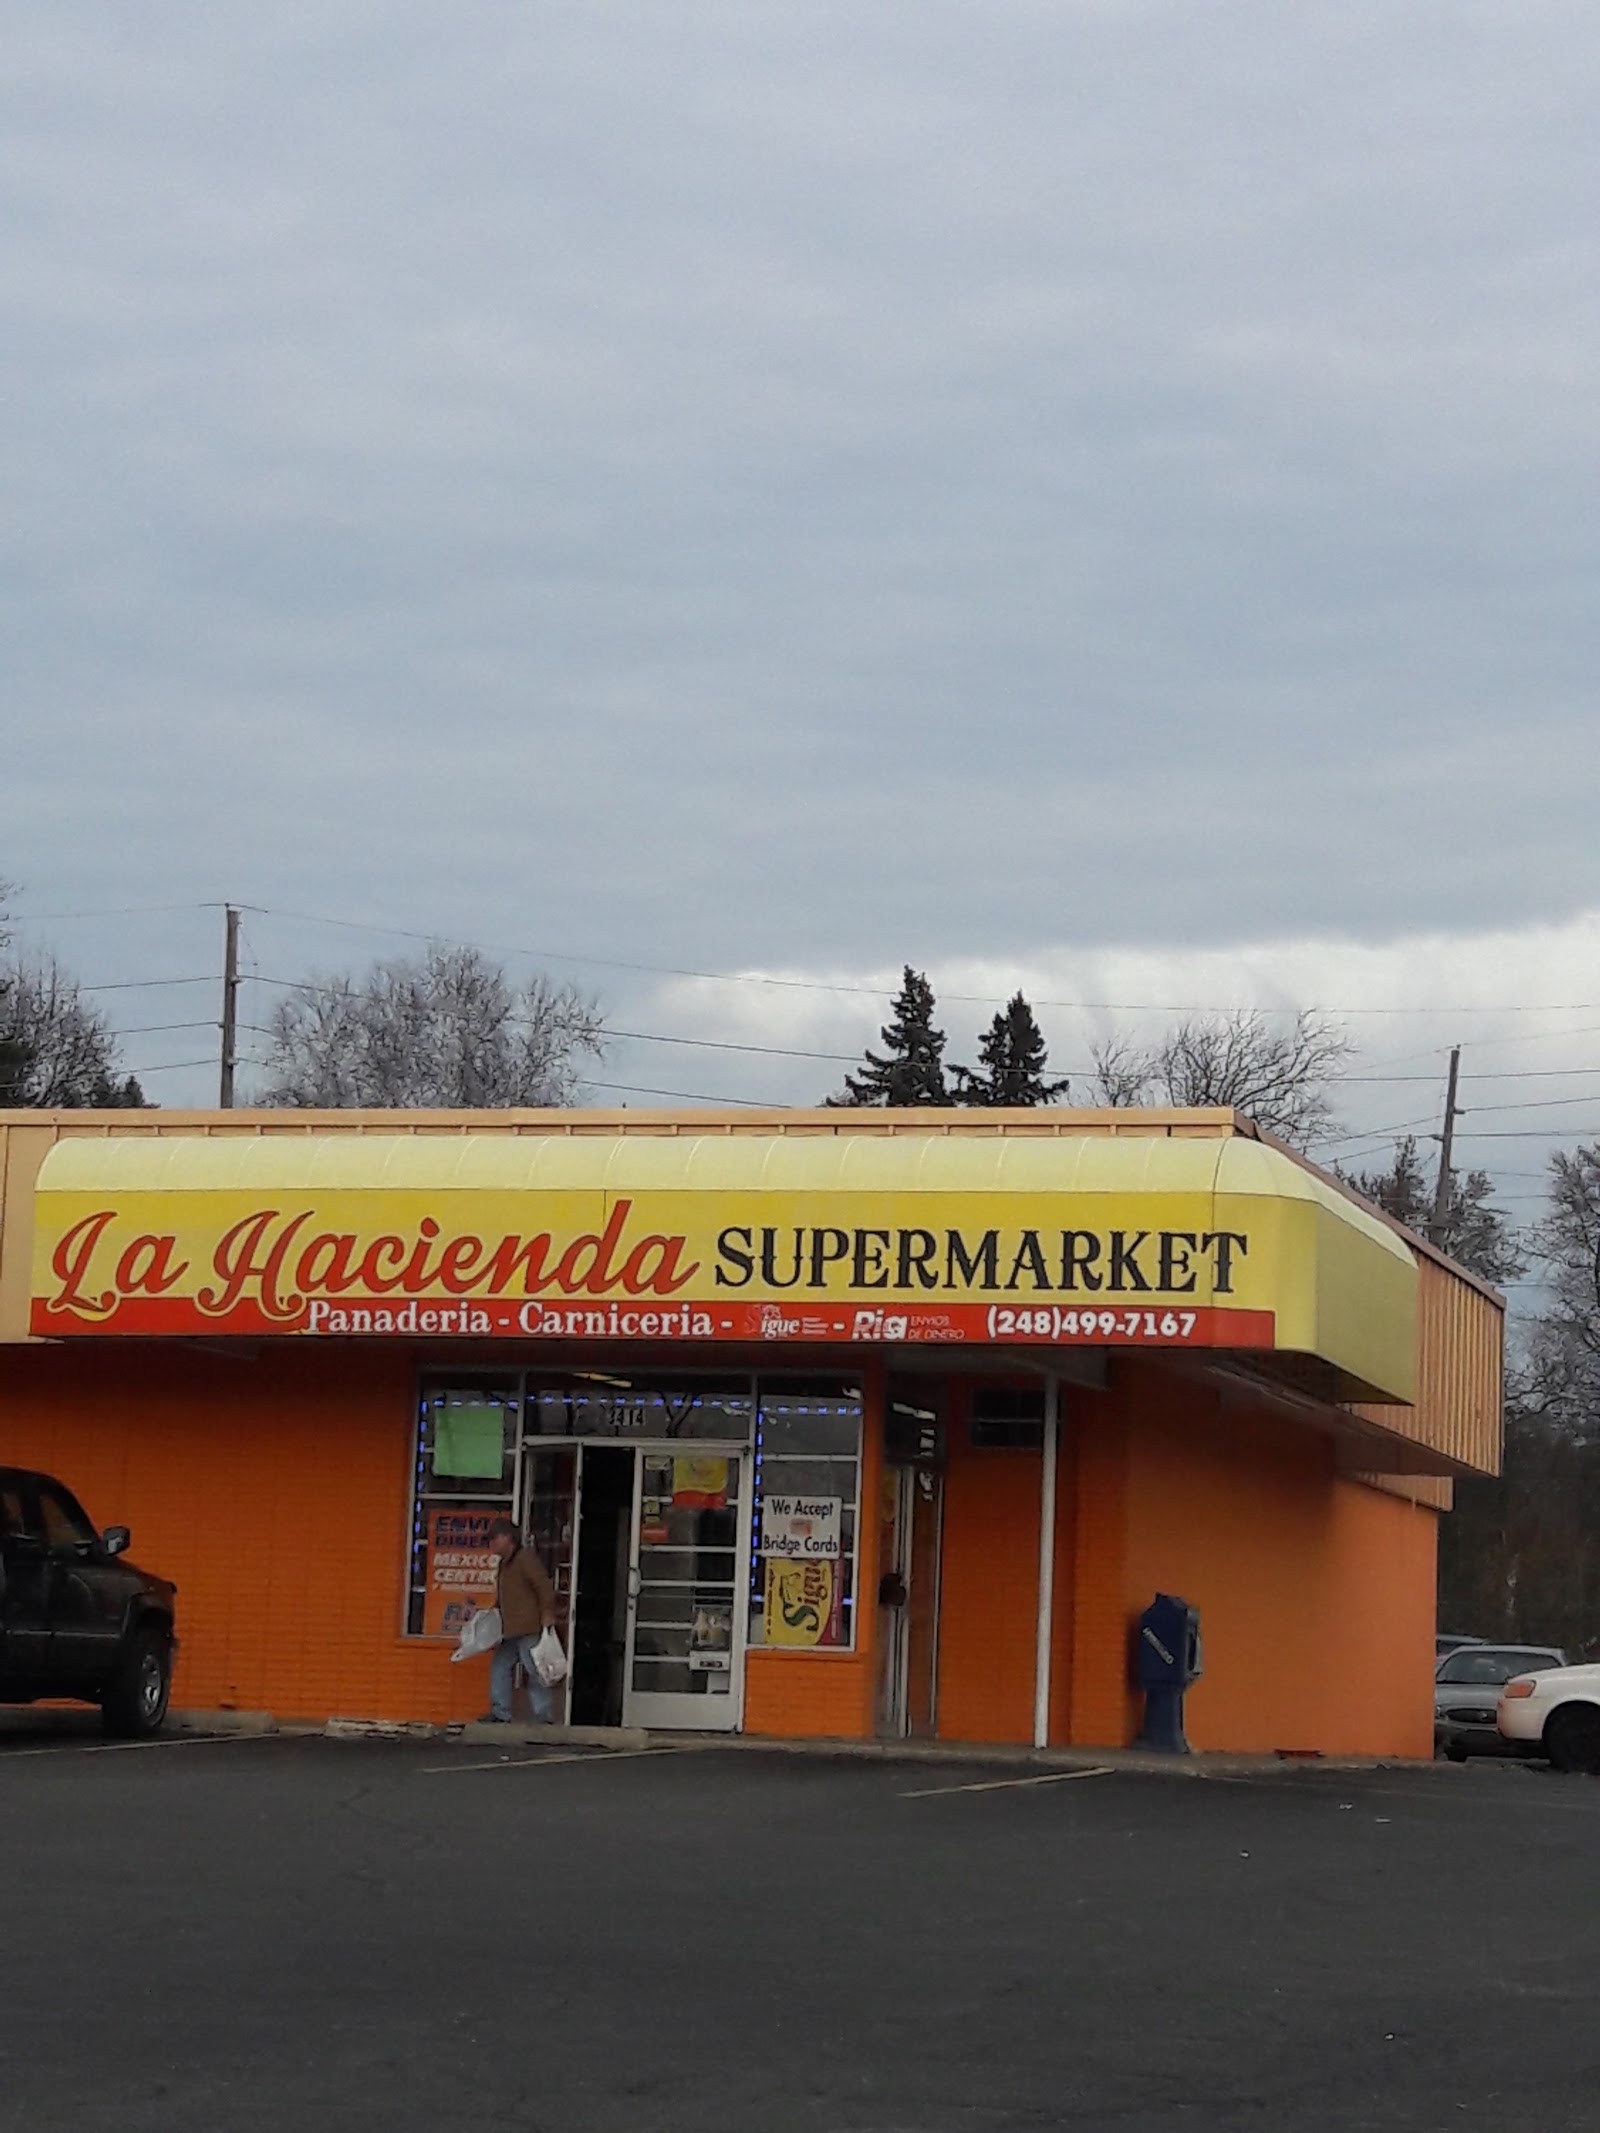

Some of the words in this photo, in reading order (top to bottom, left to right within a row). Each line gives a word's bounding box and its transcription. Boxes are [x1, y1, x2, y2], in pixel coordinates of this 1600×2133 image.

[50, 1211, 189, 1314] La
[195, 1199, 700, 1316] Hacienda
[715, 1227, 1247, 1293] SUPERMARKET
[308, 1301, 491, 1335] Panaderia
[518, 1302, 713, 1338] Carniceria
[987, 1305, 1196, 1341] (248)499-7167
[771, 1499, 791, 1515] We
[795, 1501, 834, 1519] Accept
[436, 1516, 489, 1532] ENVI
[763, 1534, 800, 1555] Bridge
[434, 1568, 497, 1584] CENTR
